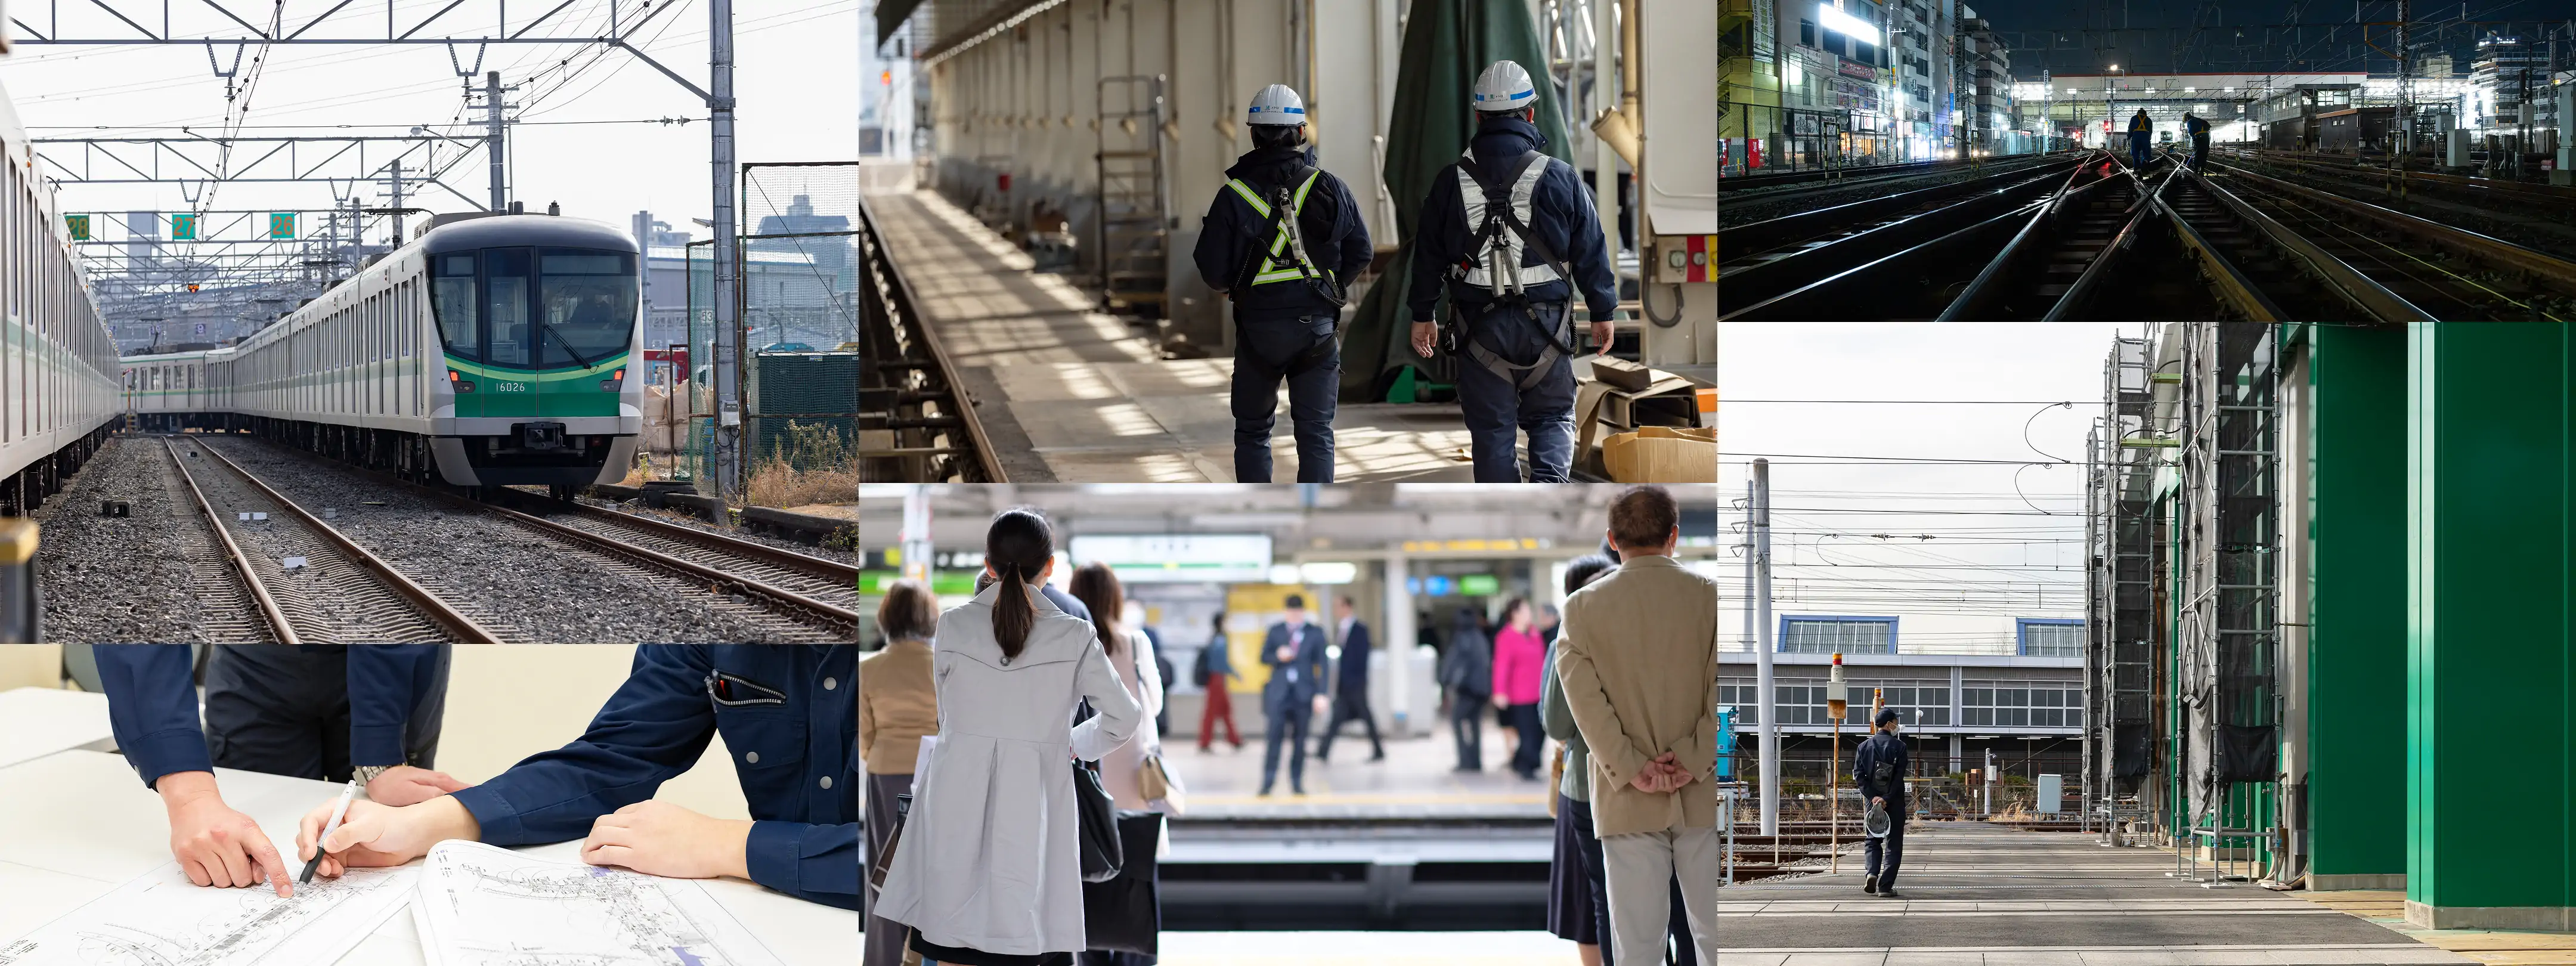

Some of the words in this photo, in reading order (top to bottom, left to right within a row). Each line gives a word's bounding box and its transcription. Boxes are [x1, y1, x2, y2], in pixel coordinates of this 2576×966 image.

[67, 218, 88, 237] 28
[174, 217, 194, 236] 27
[273, 216, 293, 235] 26
[702, 311, 713, 321] 53
[496, 383, 525, 392] 16026
